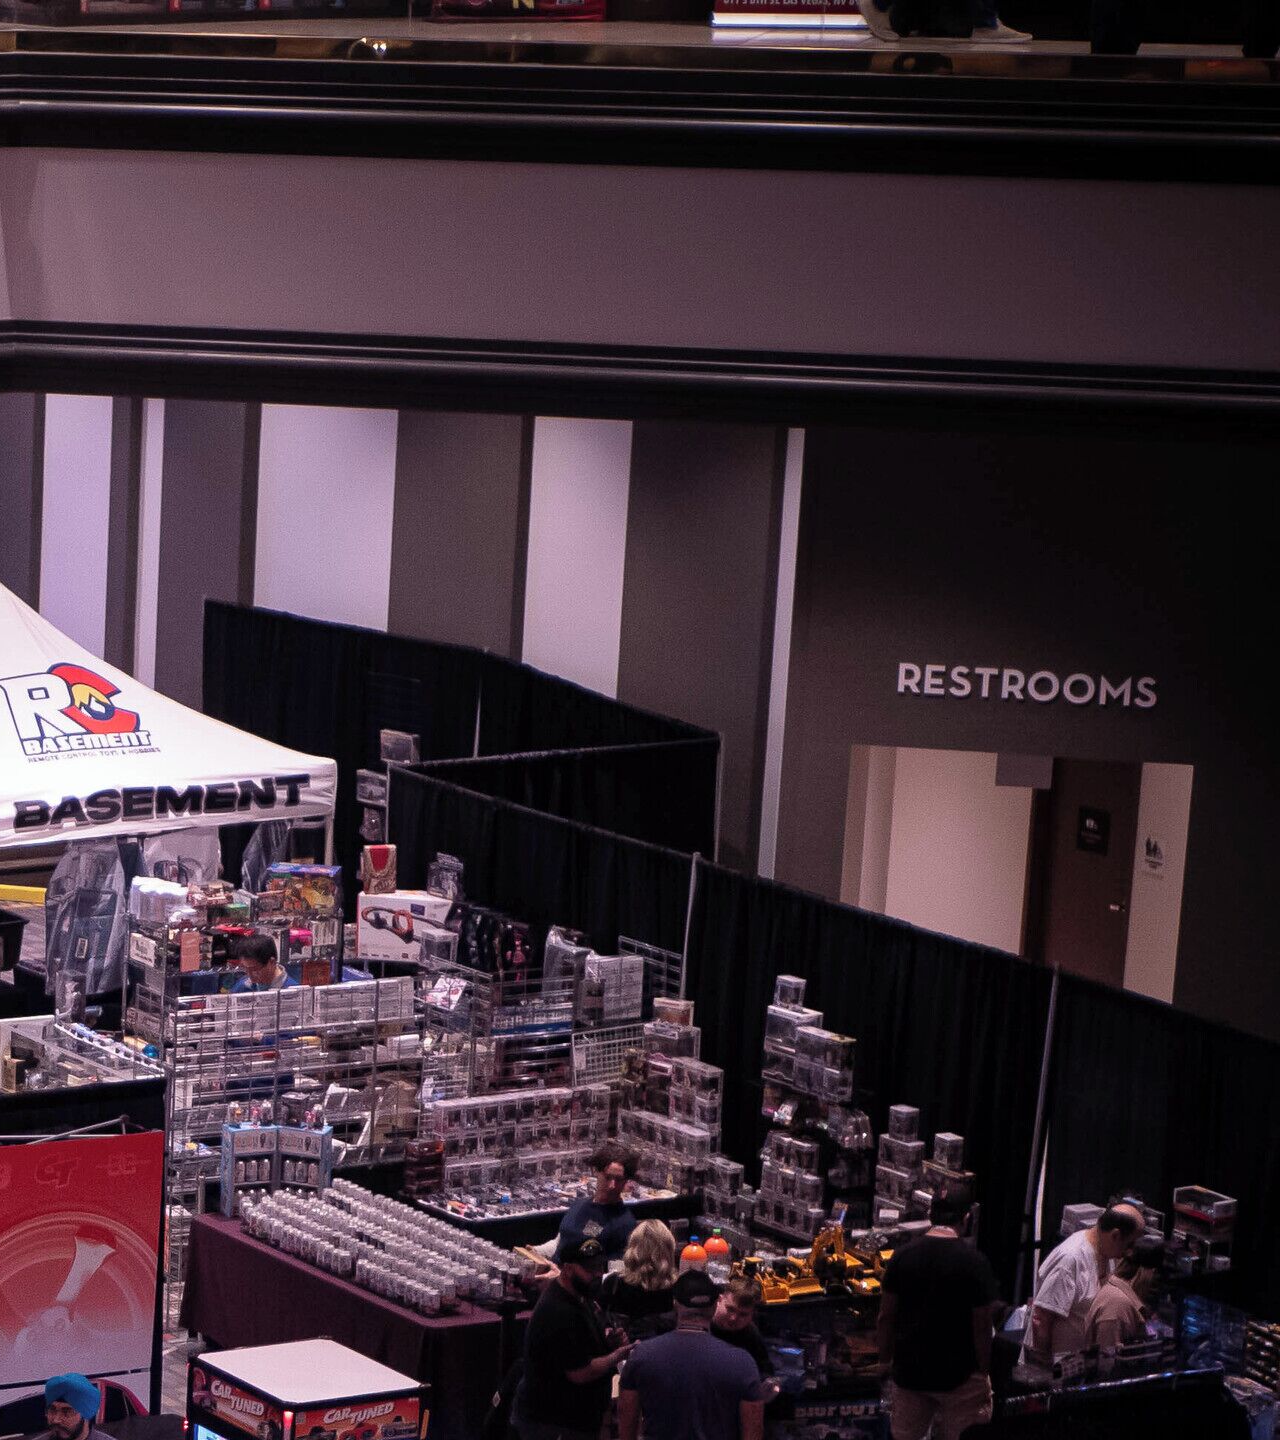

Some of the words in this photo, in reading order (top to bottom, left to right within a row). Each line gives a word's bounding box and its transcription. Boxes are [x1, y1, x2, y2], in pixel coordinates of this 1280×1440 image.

[896, 661, 1159, 709] RESTROOMS
[22, 730, 152, 756] BASEMENT
[11, 773, 311, 834] BASEMENT
